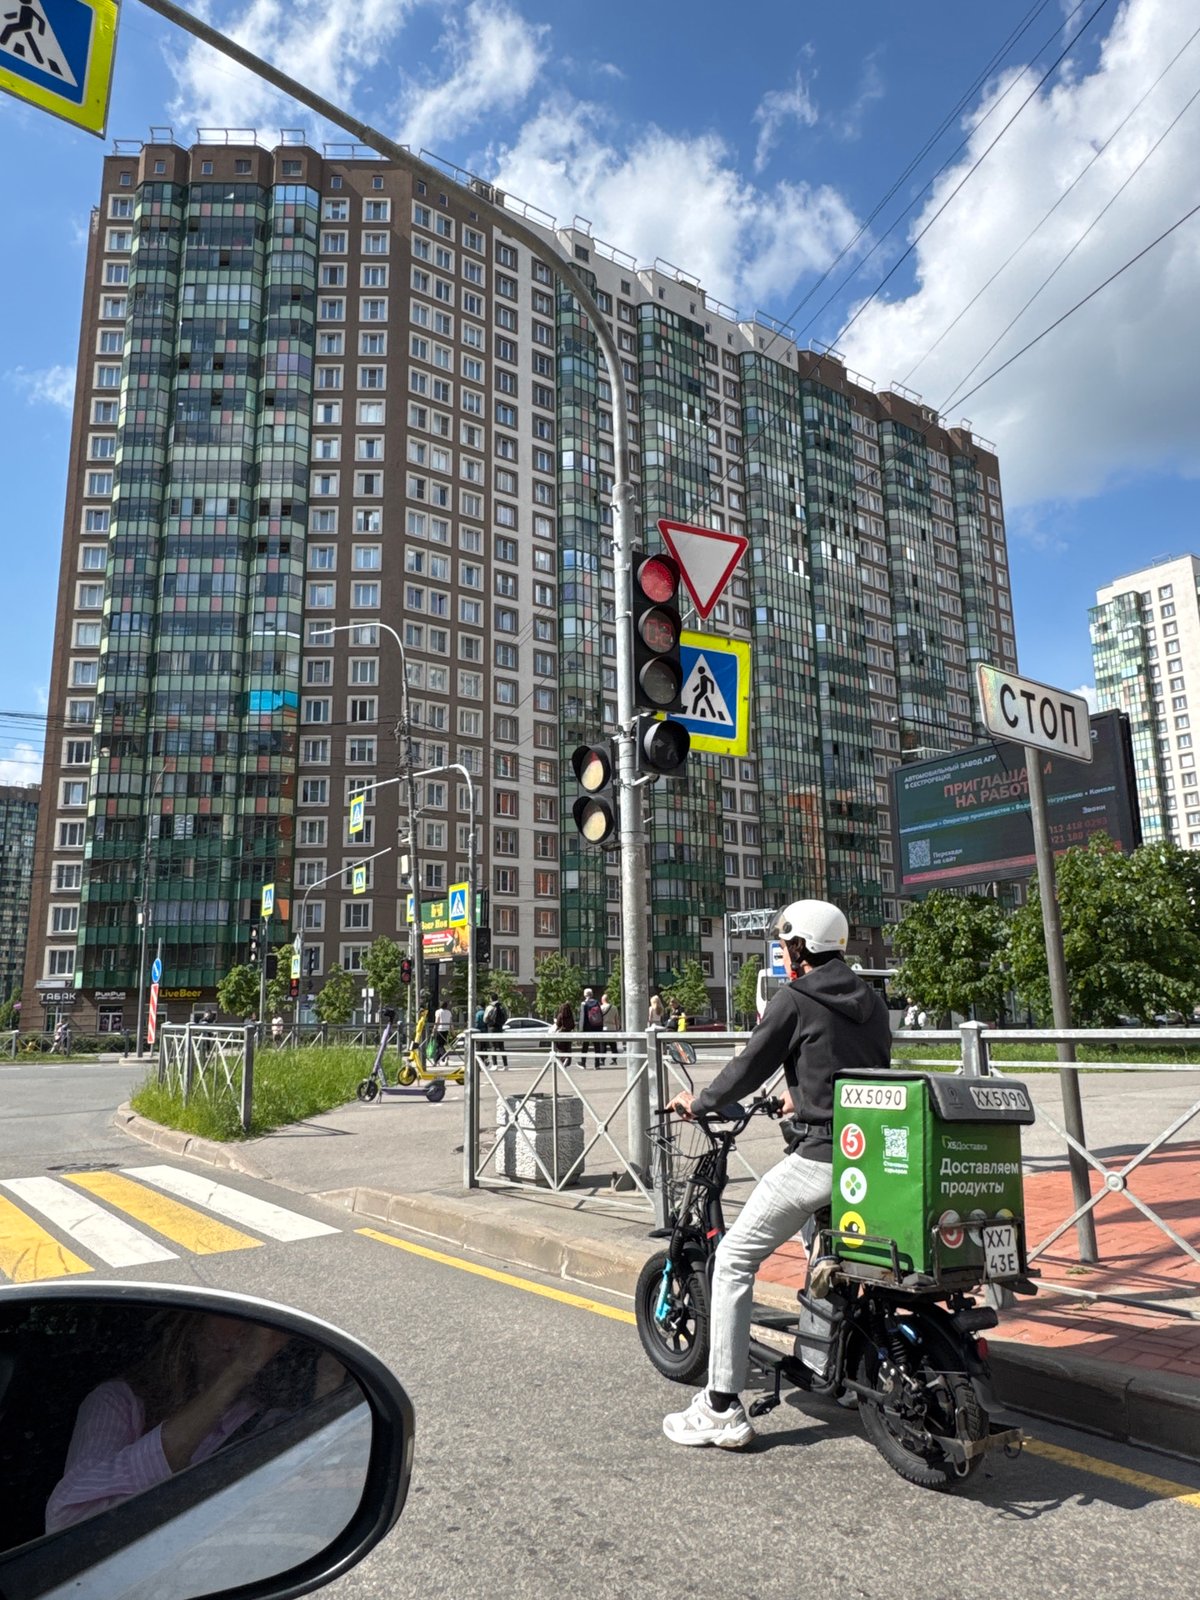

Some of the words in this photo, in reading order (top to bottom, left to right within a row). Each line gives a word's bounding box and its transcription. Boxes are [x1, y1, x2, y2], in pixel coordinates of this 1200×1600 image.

[1000, 683, 1079, 747] СТОП
[955, 795, 977, 809] НА
[980, 781, 1030, 804] РАБОТ
[39, 992, 76, 1001] ТАБАК
[159, 988, 202, 998] LiveBeer
[940, 1158, 1019, 1176] Доставляем
[941, 1181, 1004, 1198] продукты
